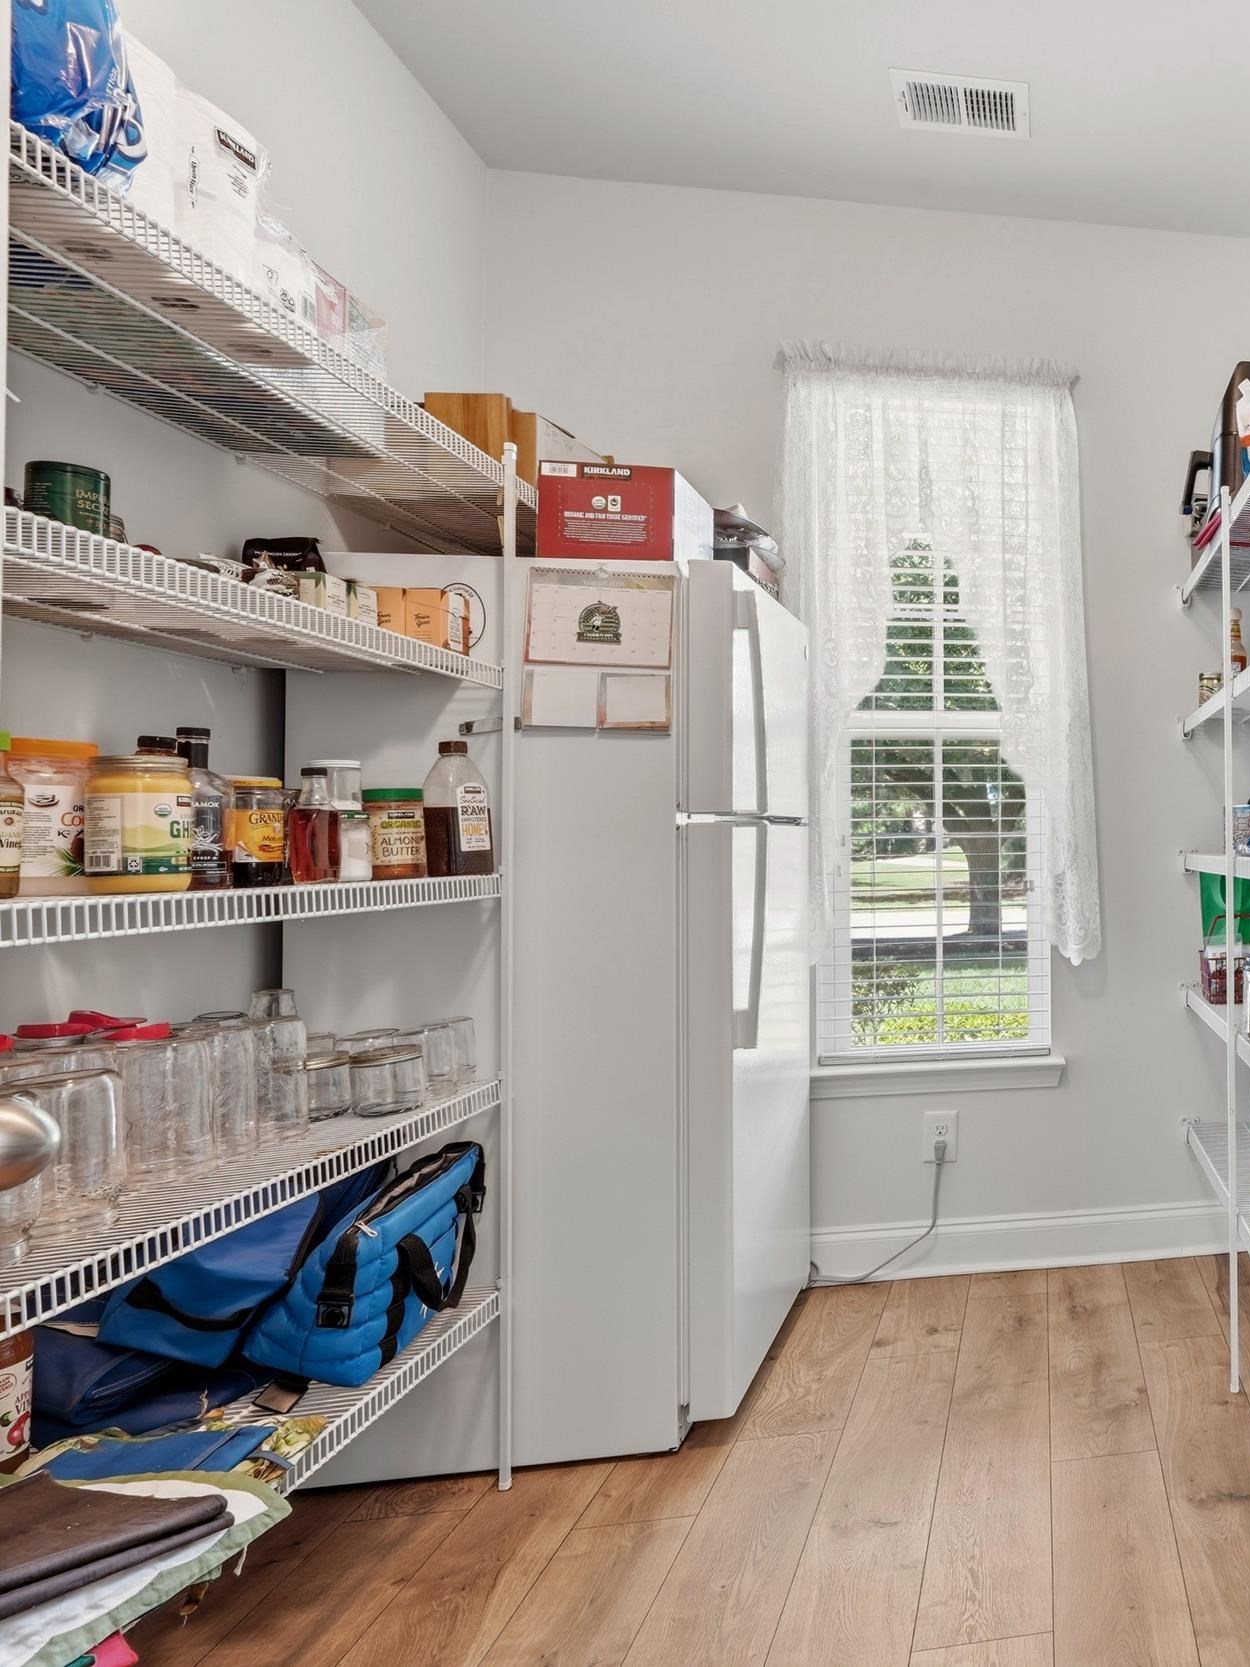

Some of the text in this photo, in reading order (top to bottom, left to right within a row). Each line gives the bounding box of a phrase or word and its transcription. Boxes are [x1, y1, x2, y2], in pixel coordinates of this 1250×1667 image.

[583, 466, 631, 476] KIRKLAND
[460, 805, 486, 816] RAW
[380, 820, 421, 829] ORGANIC
[380, 835, 424, 846] ALMOND
[382, 846, 421, 858] BUTTER
